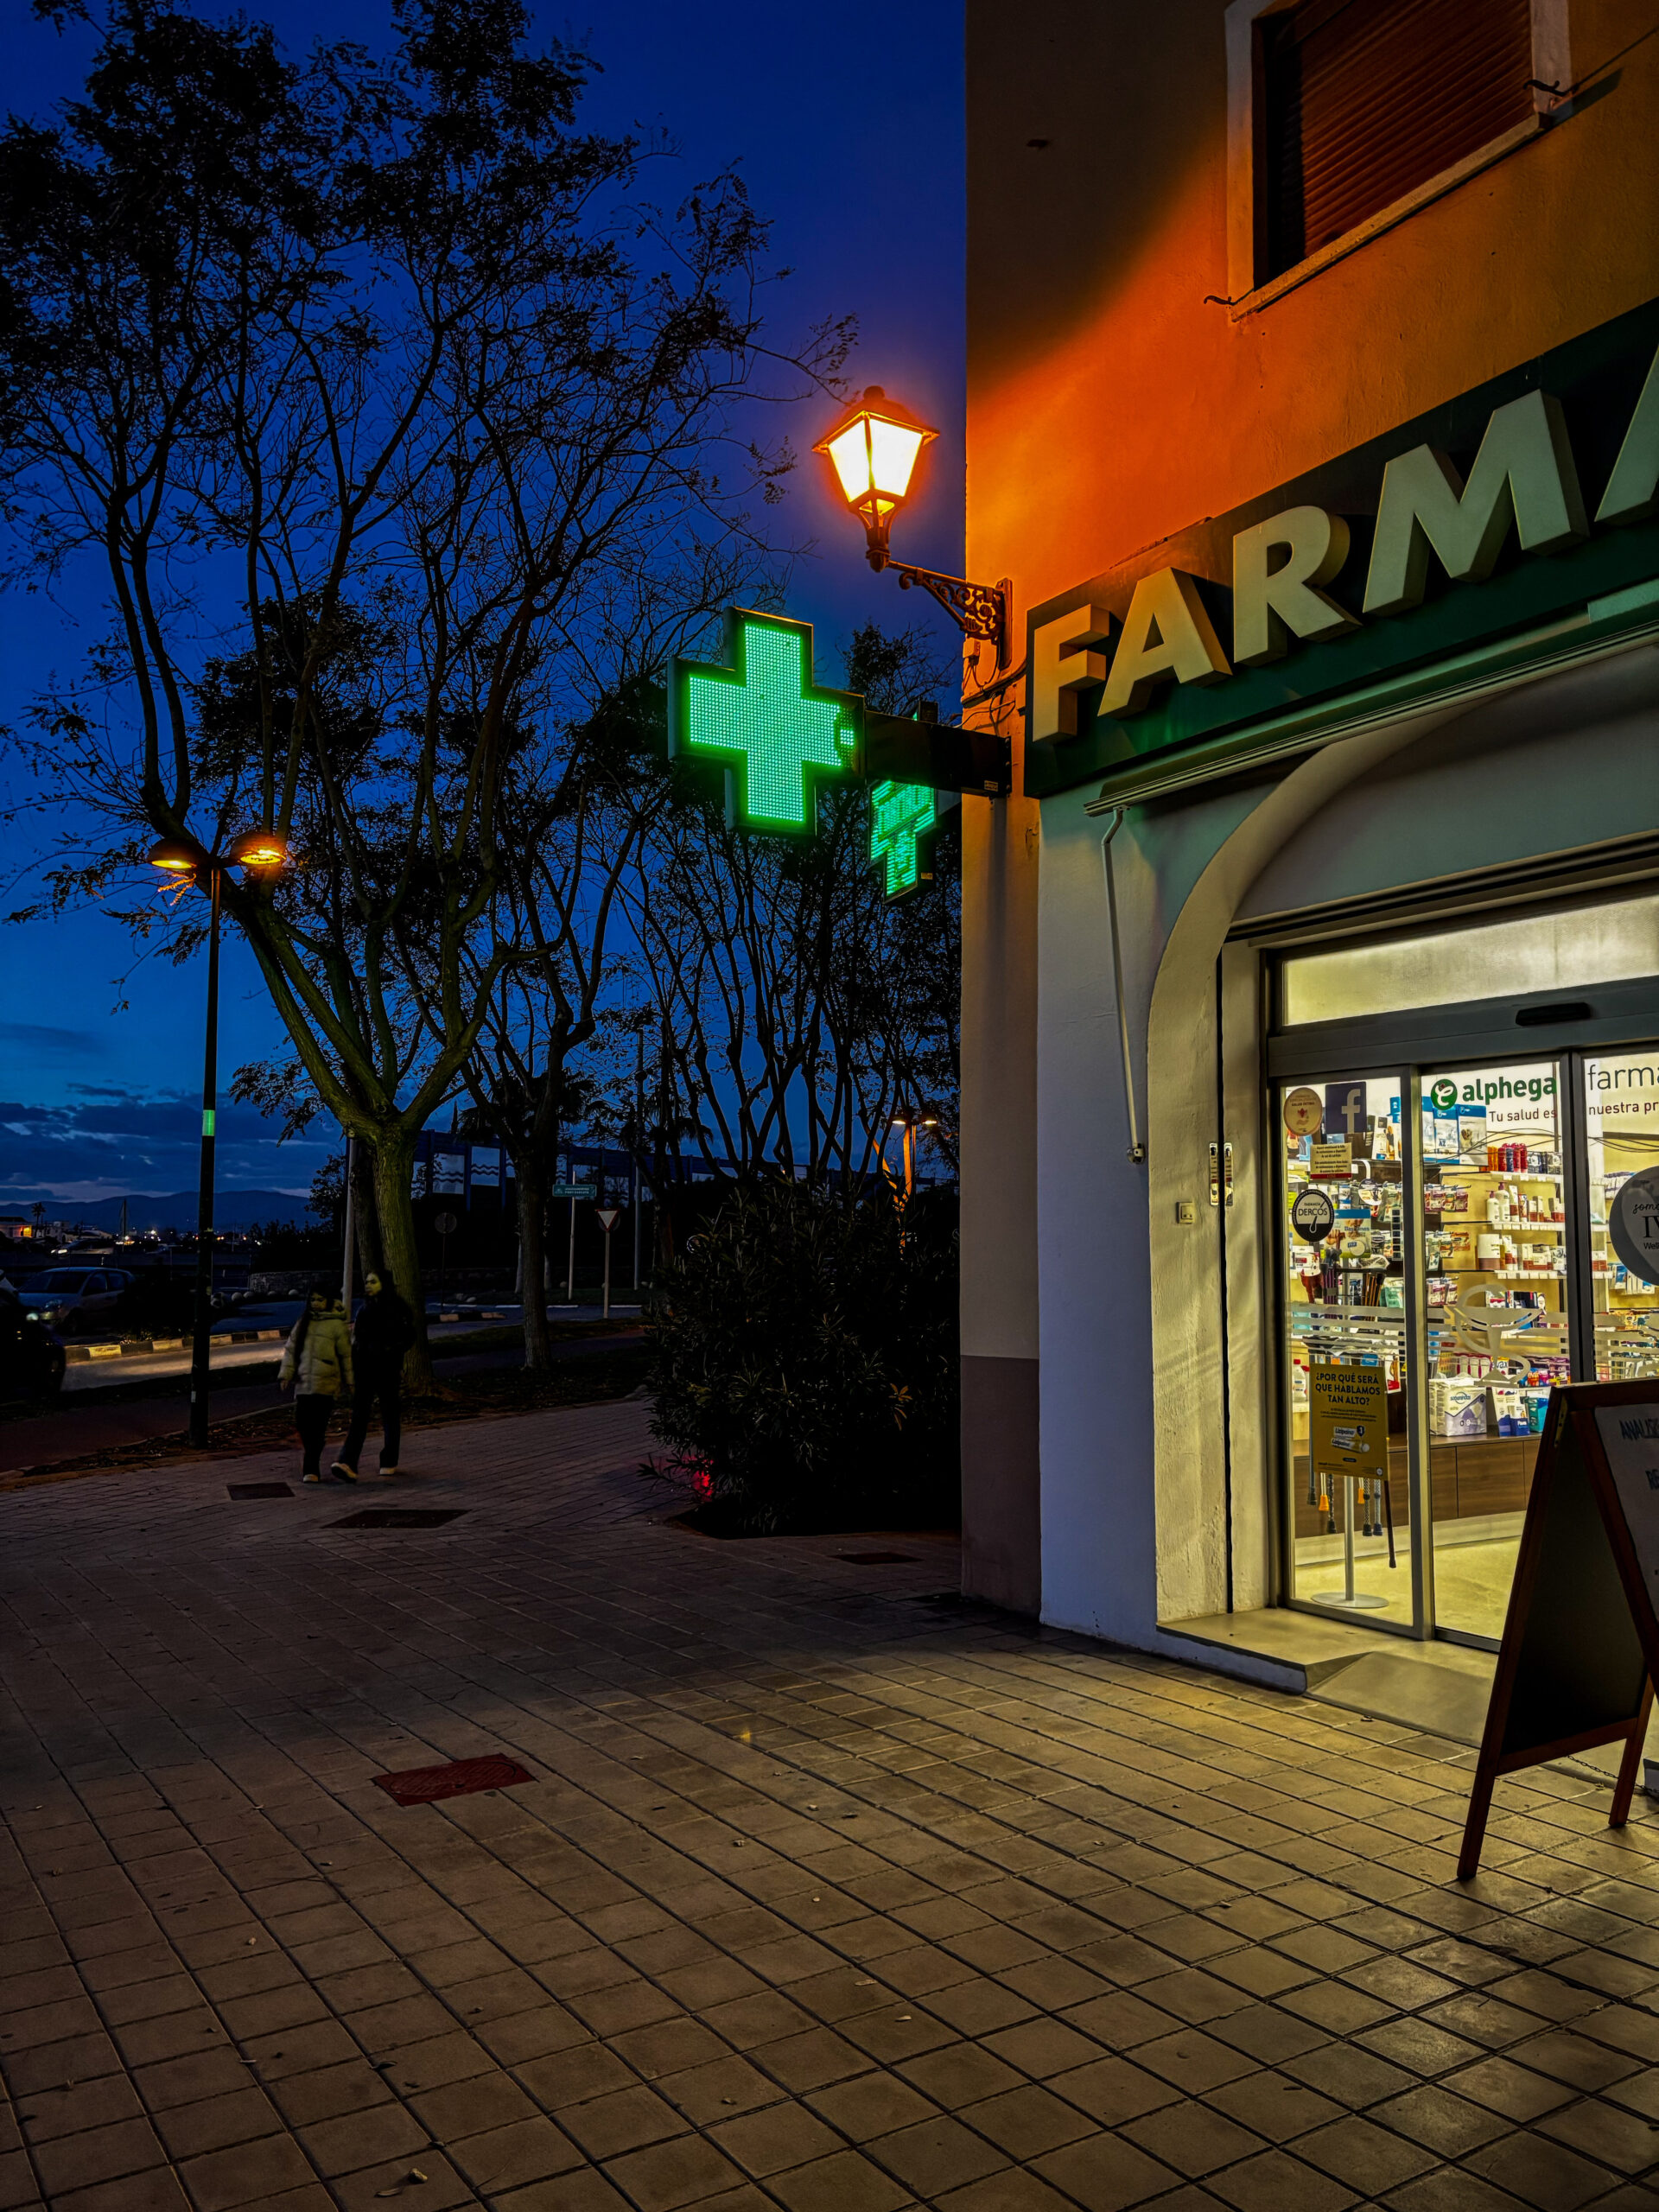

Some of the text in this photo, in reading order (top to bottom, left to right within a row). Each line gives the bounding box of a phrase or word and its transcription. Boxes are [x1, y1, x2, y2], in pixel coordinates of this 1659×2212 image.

[1462, 1064, 1659, 1105] alphega farm
[1489, 1111, 1503, 1122] Tu
[1507, 1108, 1539, 1122] salud
[1543, 1109, 1557, 1119] es
[1588, 1102, 1639, 1116] nuestra
[1315, 1372, 1379, 1384] ¿POR QUÉ SERÁ
[1315, 1383, 1381, 1395] QUE HABLAMOS
[1327, 1395, 1370, 1406] TAN ALTO?
